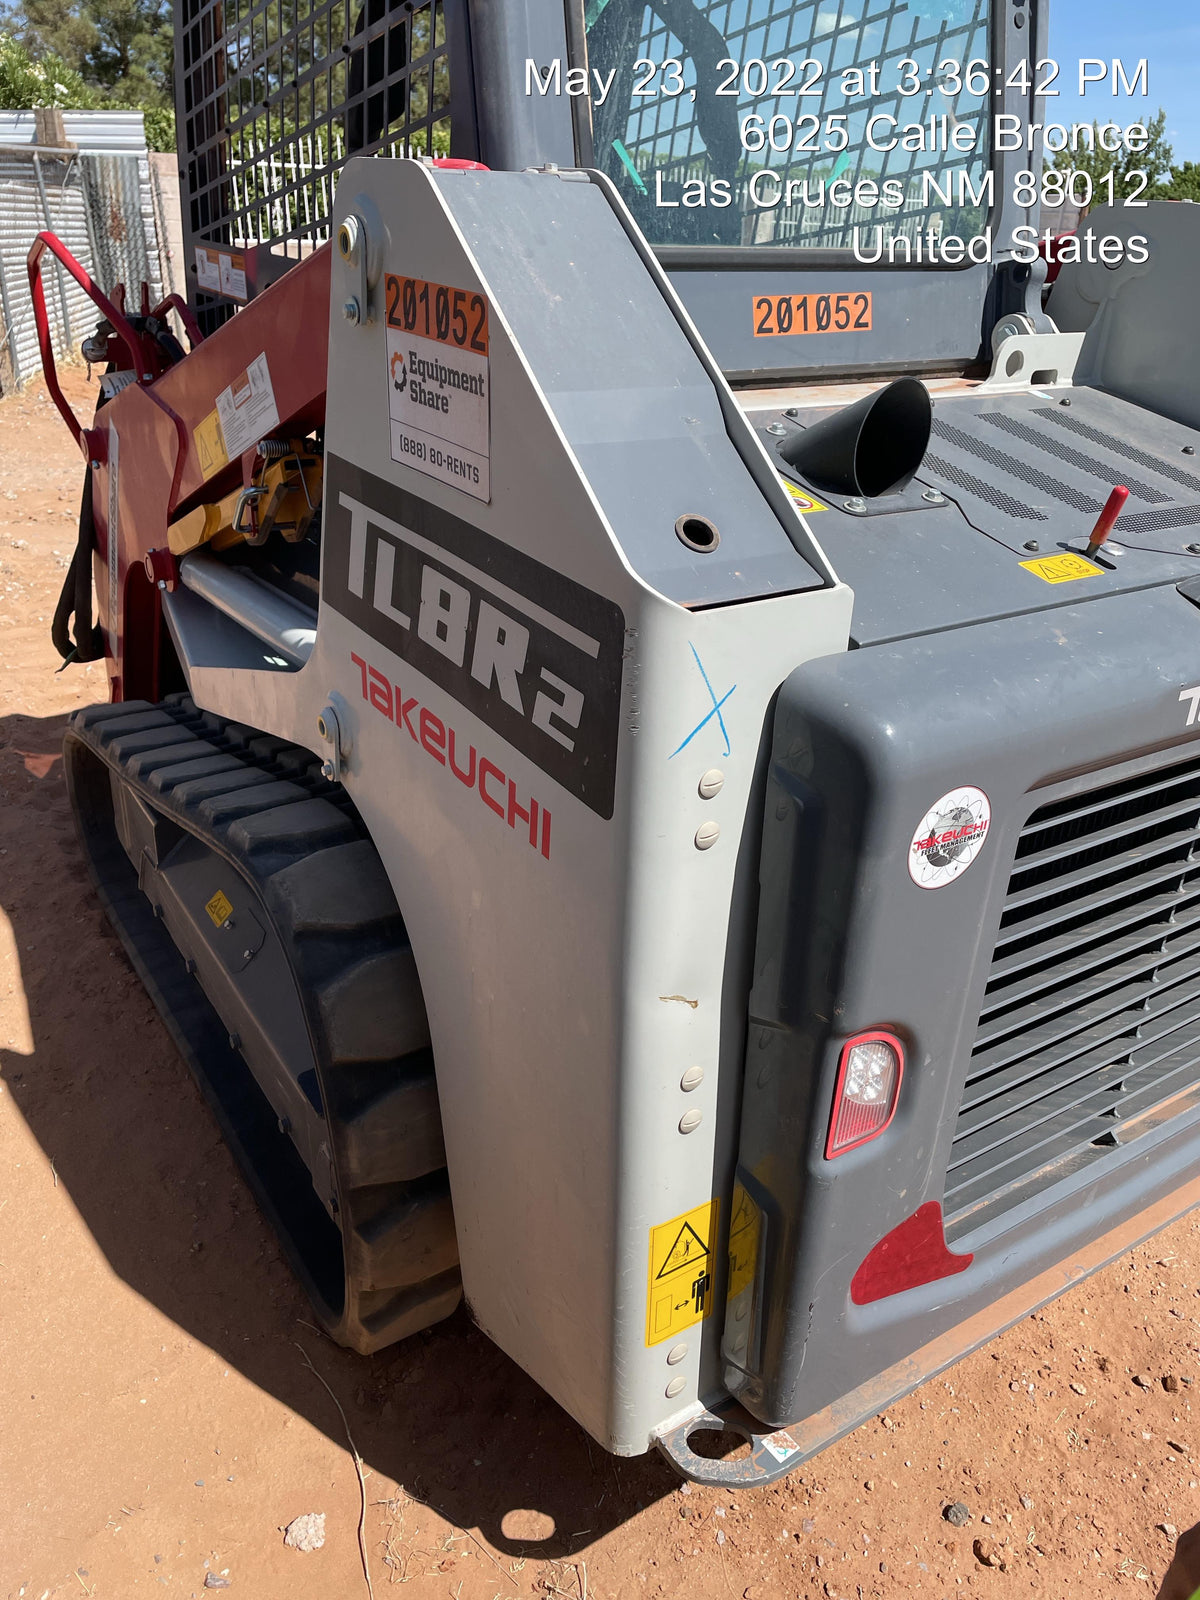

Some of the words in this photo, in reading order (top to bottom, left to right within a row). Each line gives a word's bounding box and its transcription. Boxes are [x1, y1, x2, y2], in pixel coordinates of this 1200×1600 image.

[387, 276, 488, 351] 201052
[756, 294, 869, 334] 201052
[408, 350, 485, 397] Equipment
[410, 379, 449, 414] Share
[399, 433, 428, 461] (888)
[430, 447, 480, 484] 80-RENTS
[921, 844, 940, 856] FLEET
[940, 831, 985, 850] MANAGEMENT
